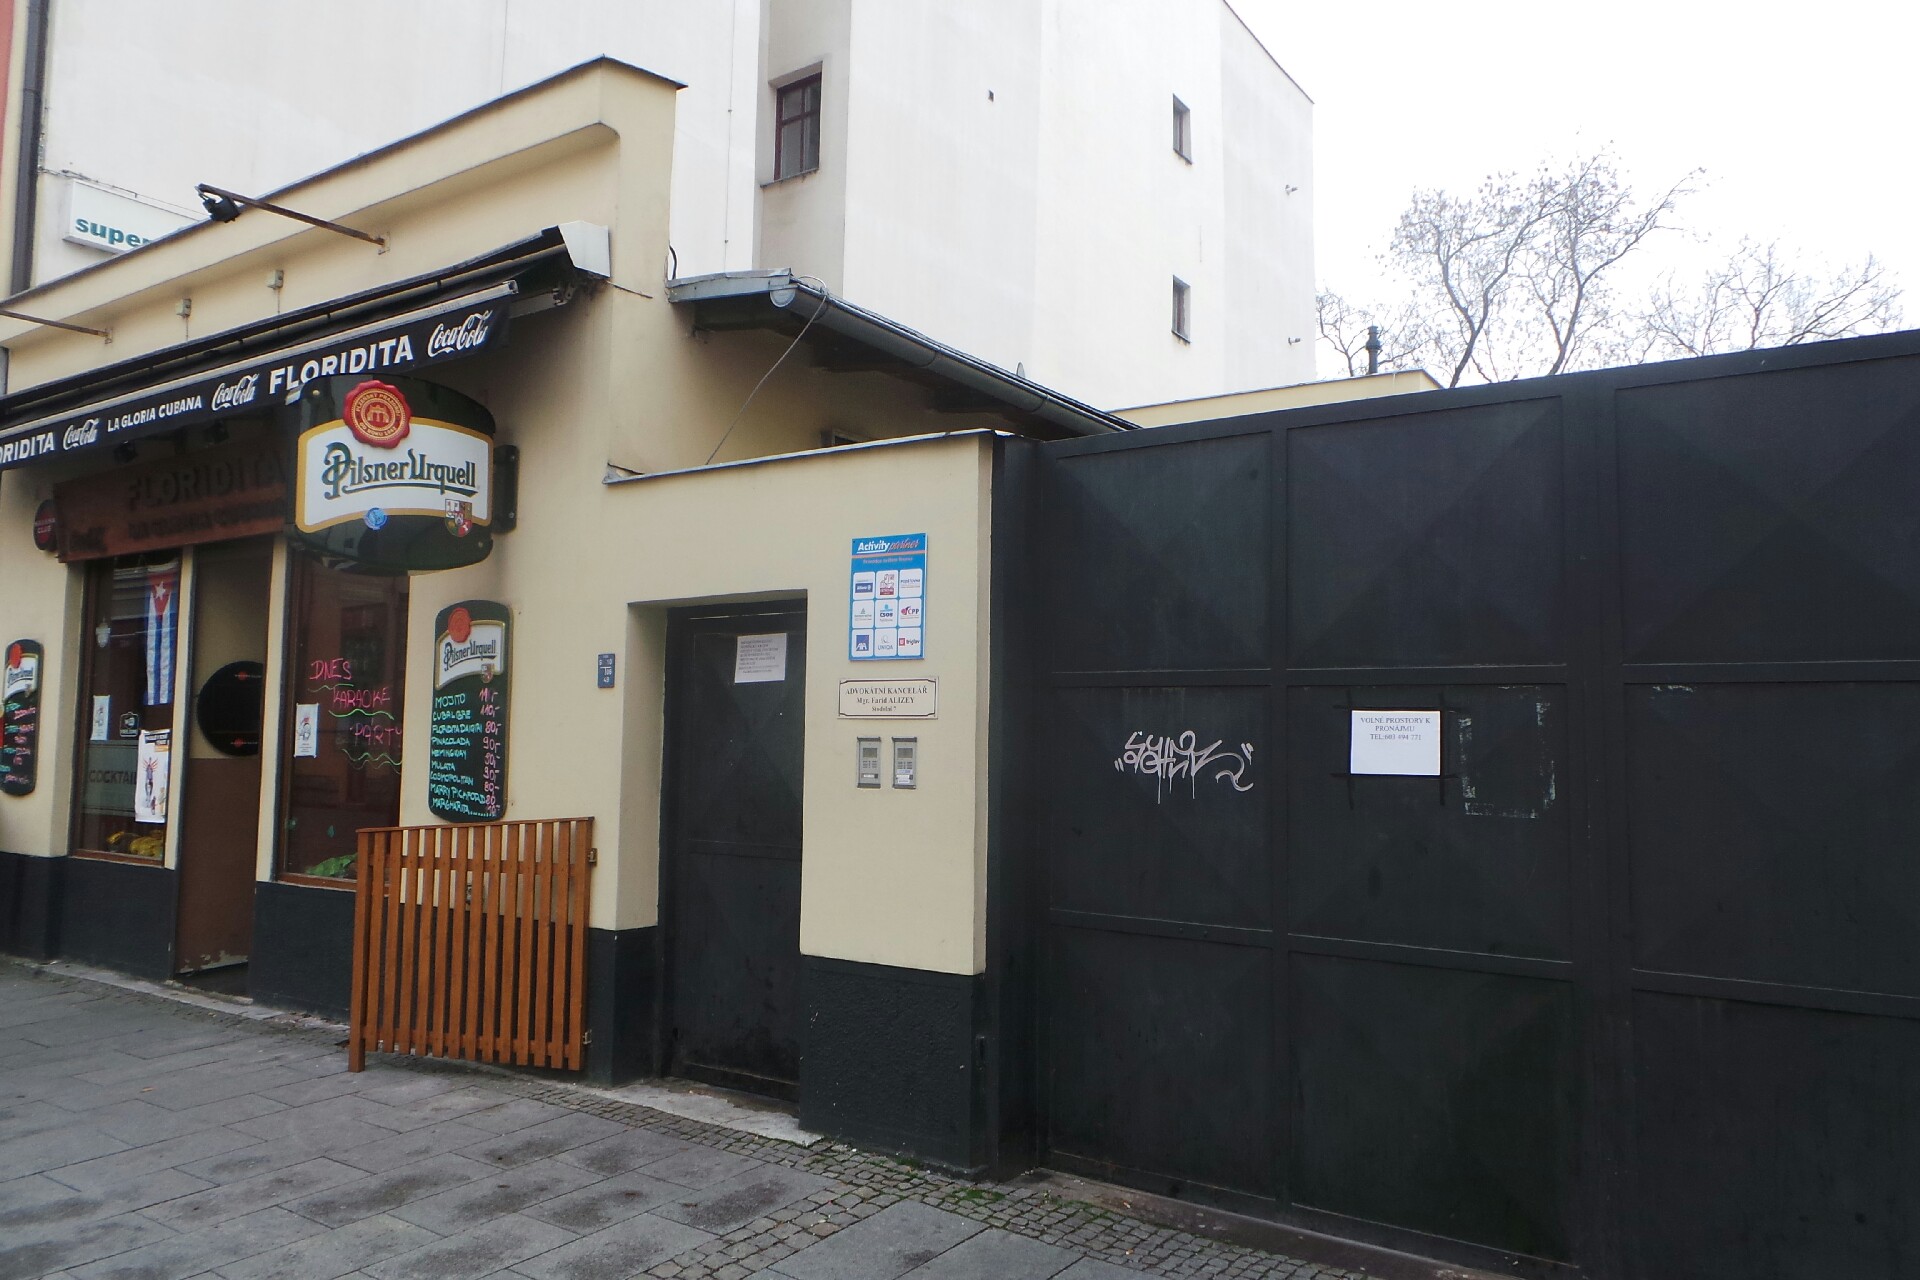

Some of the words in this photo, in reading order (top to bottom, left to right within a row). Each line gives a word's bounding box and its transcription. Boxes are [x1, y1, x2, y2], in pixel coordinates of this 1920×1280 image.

[427, 310, 493, 357] Coca-Cola
[269, 334, 413, 394] FLORIDITA
[211, 373, 259, 411] Coca-Cola
[107, 418, 120, 432] LA
[121, 408, 156, 428] GLORIA
[158, 395, 202, 418] CUBANA
[63, 418, 99, 450] Coca-Cola
[321, 441, 410, 500] Pilsner
[407, 448, 477, 495] Urquell
[857, 540, 890, 553] Activity
[309, 658, 352, 681] DNES
[443, 642, 472, 672] Pilsner
[332, 686, 391, 708] KARAOKE
[435, 693, 466, 708] MOJITO
[887, 685, 928, 694] KANCELÁŘ
[1360, 716, 1385, 724] VOLNÉ
[1375, 724, 1415, 732] PRONÁJMU
